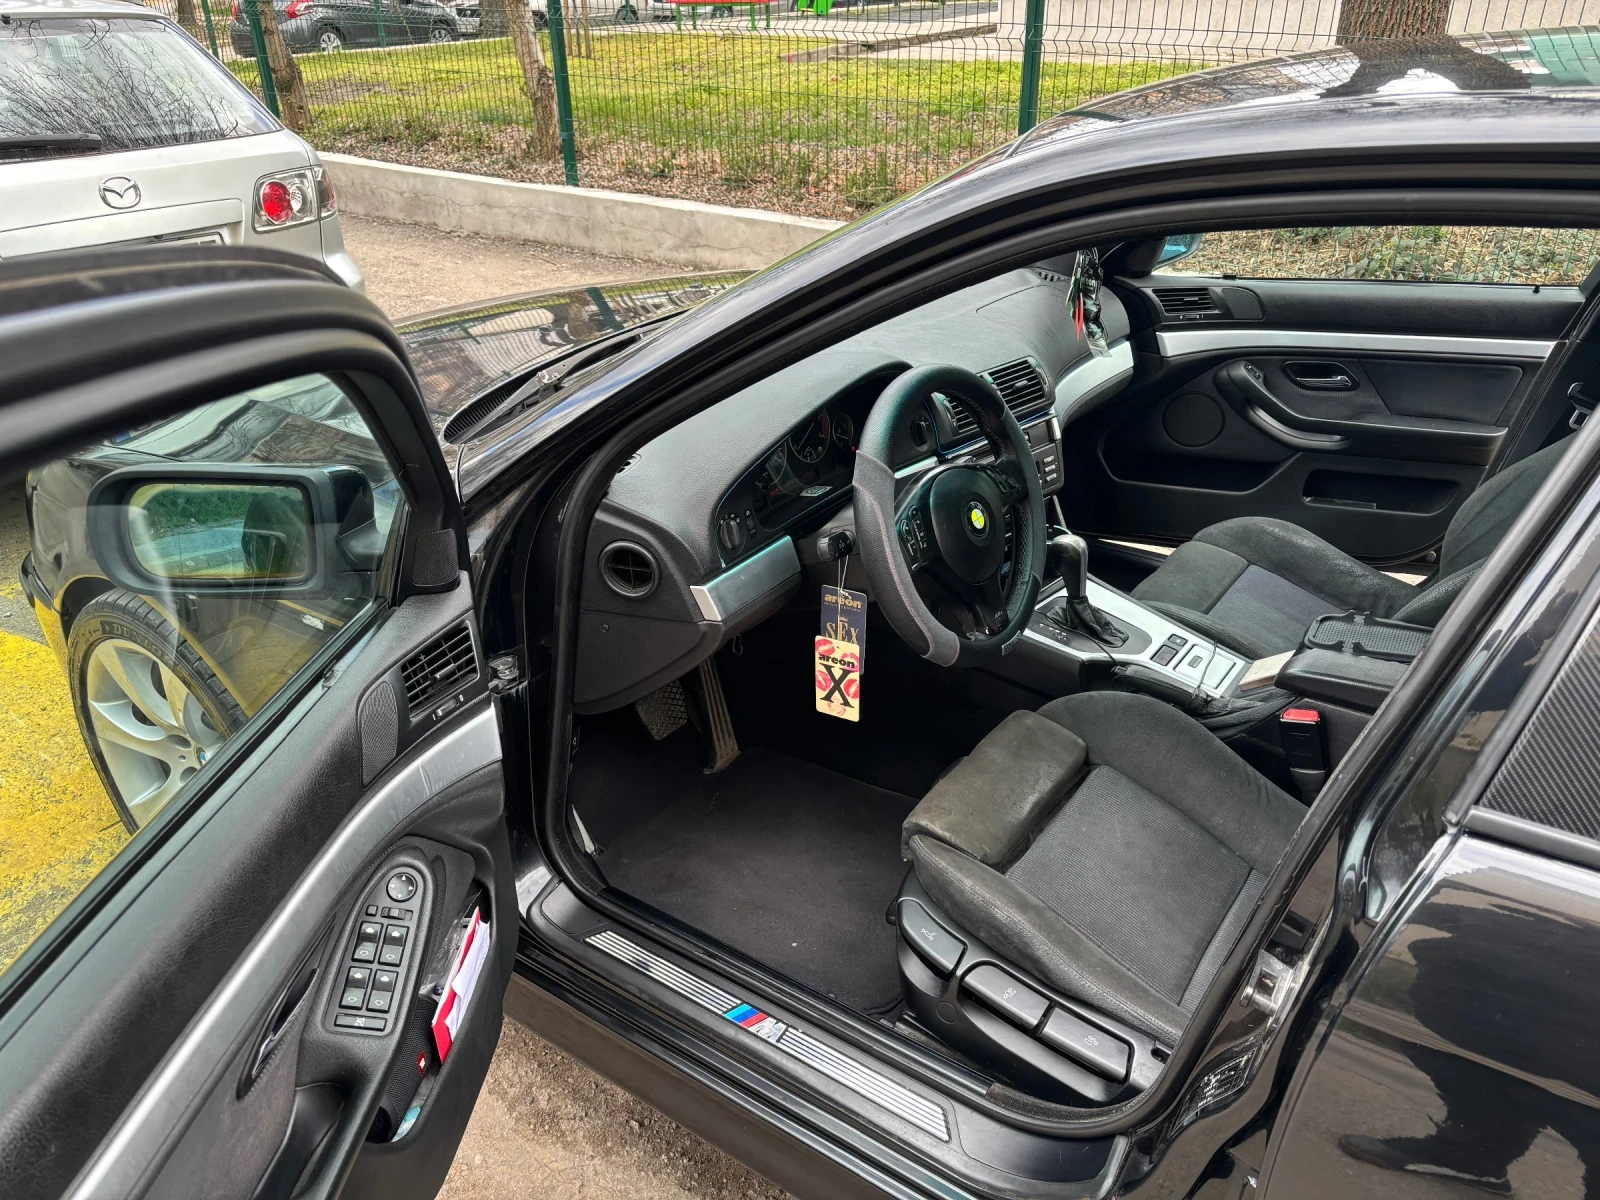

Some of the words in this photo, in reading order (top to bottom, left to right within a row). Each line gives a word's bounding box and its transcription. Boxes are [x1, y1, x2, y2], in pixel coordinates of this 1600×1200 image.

[824, 594, 862, 609] areon
[826, 621, 860, 645] SEX
[819, 653, 855, 669] areon
[819, 662, 855, 709] X
